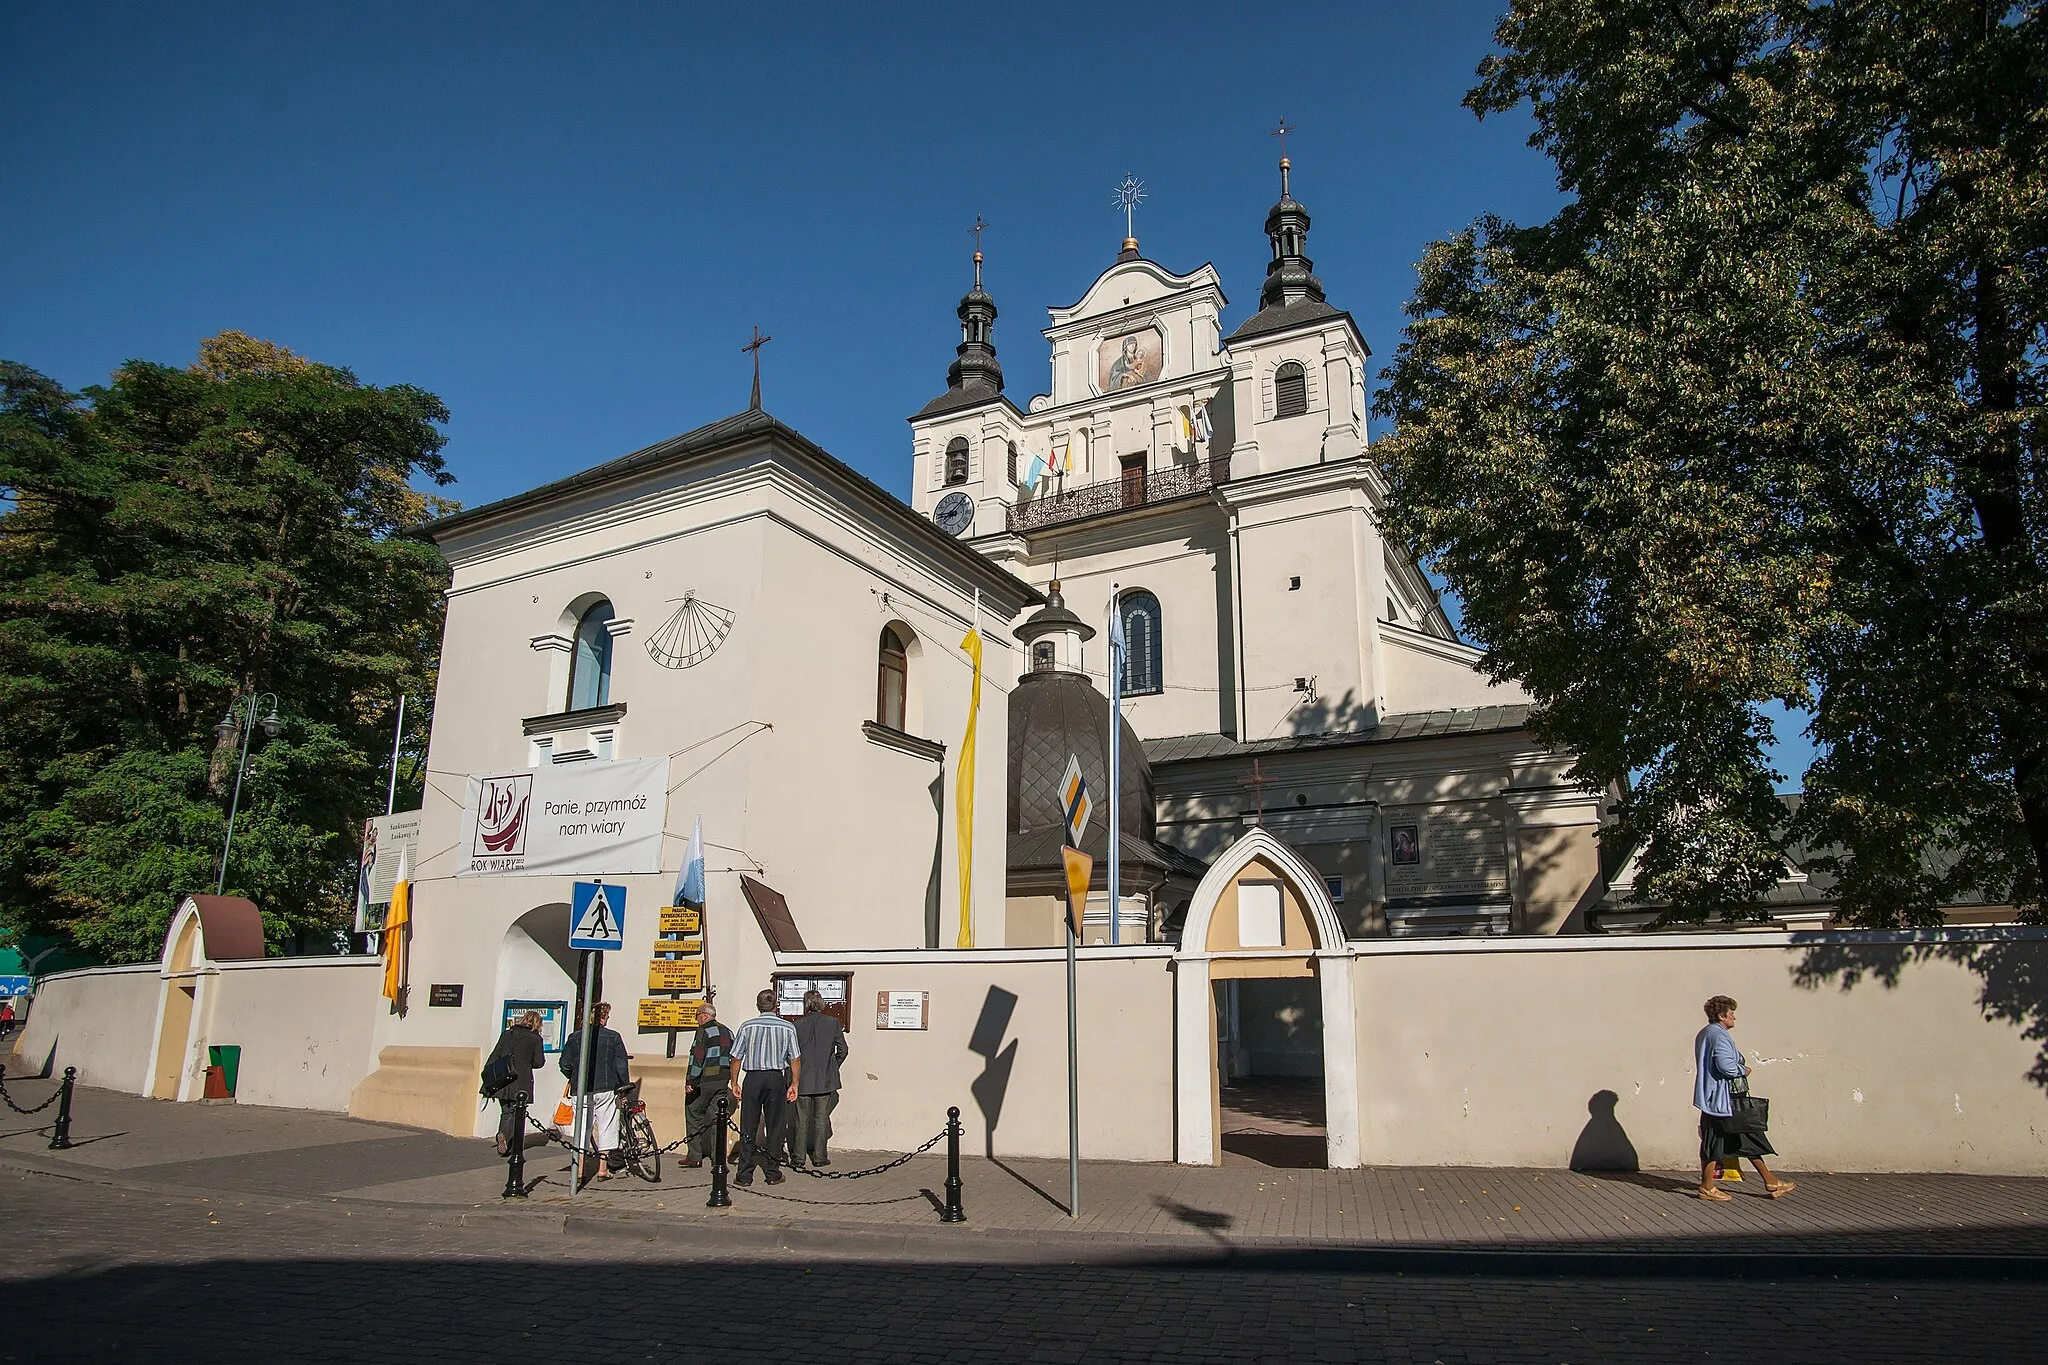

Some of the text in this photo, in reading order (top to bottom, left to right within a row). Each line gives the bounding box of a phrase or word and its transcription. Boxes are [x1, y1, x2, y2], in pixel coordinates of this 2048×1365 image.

[544, 795, 647, 816] Panie, przymnóż
[560, 819, 625, 836] nam wiary
[471, 859, 515, 871] ROK WIARY
